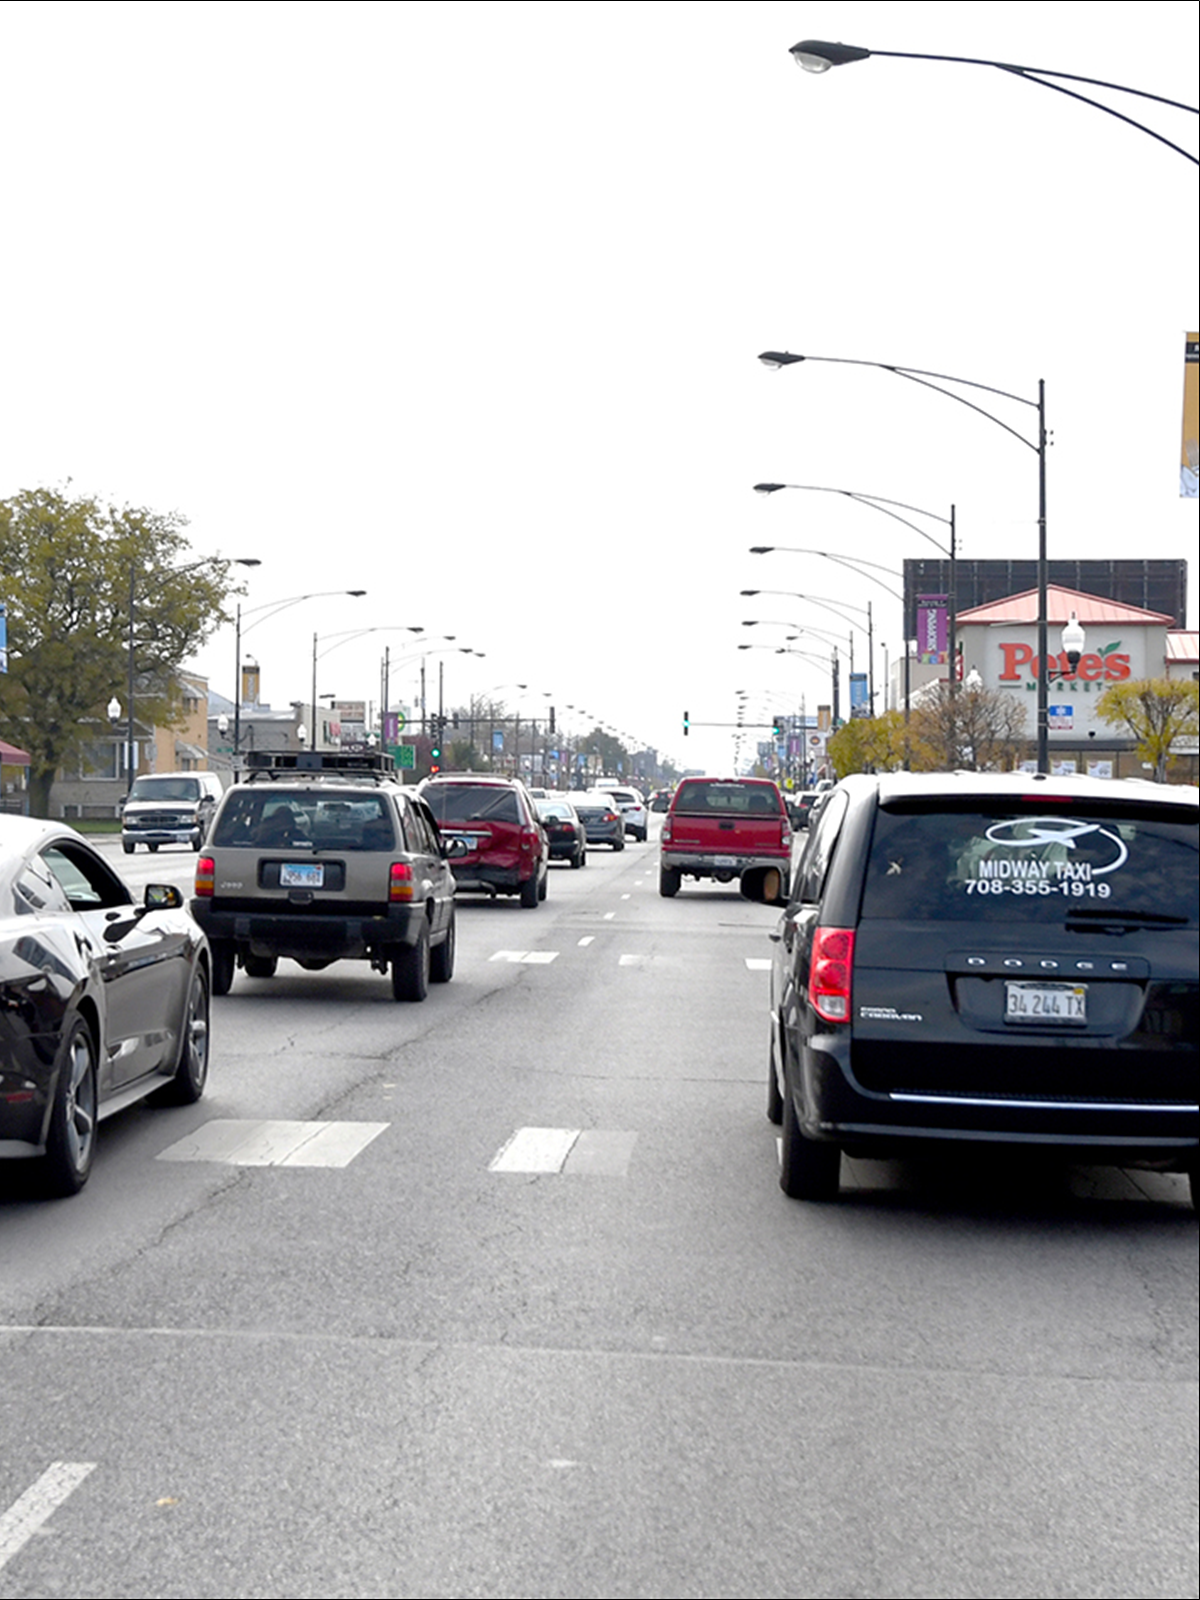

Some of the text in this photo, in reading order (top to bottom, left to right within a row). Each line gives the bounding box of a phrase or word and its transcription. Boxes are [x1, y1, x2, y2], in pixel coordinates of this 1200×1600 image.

[979, 859, 1092, 882] MIDWAY TAXI
[965, 880, 1112, 898] 708-355-1919
[967, 957, 1128, 971] DODGE
[1009, 994, 1085, 1016] 34 244 TX
